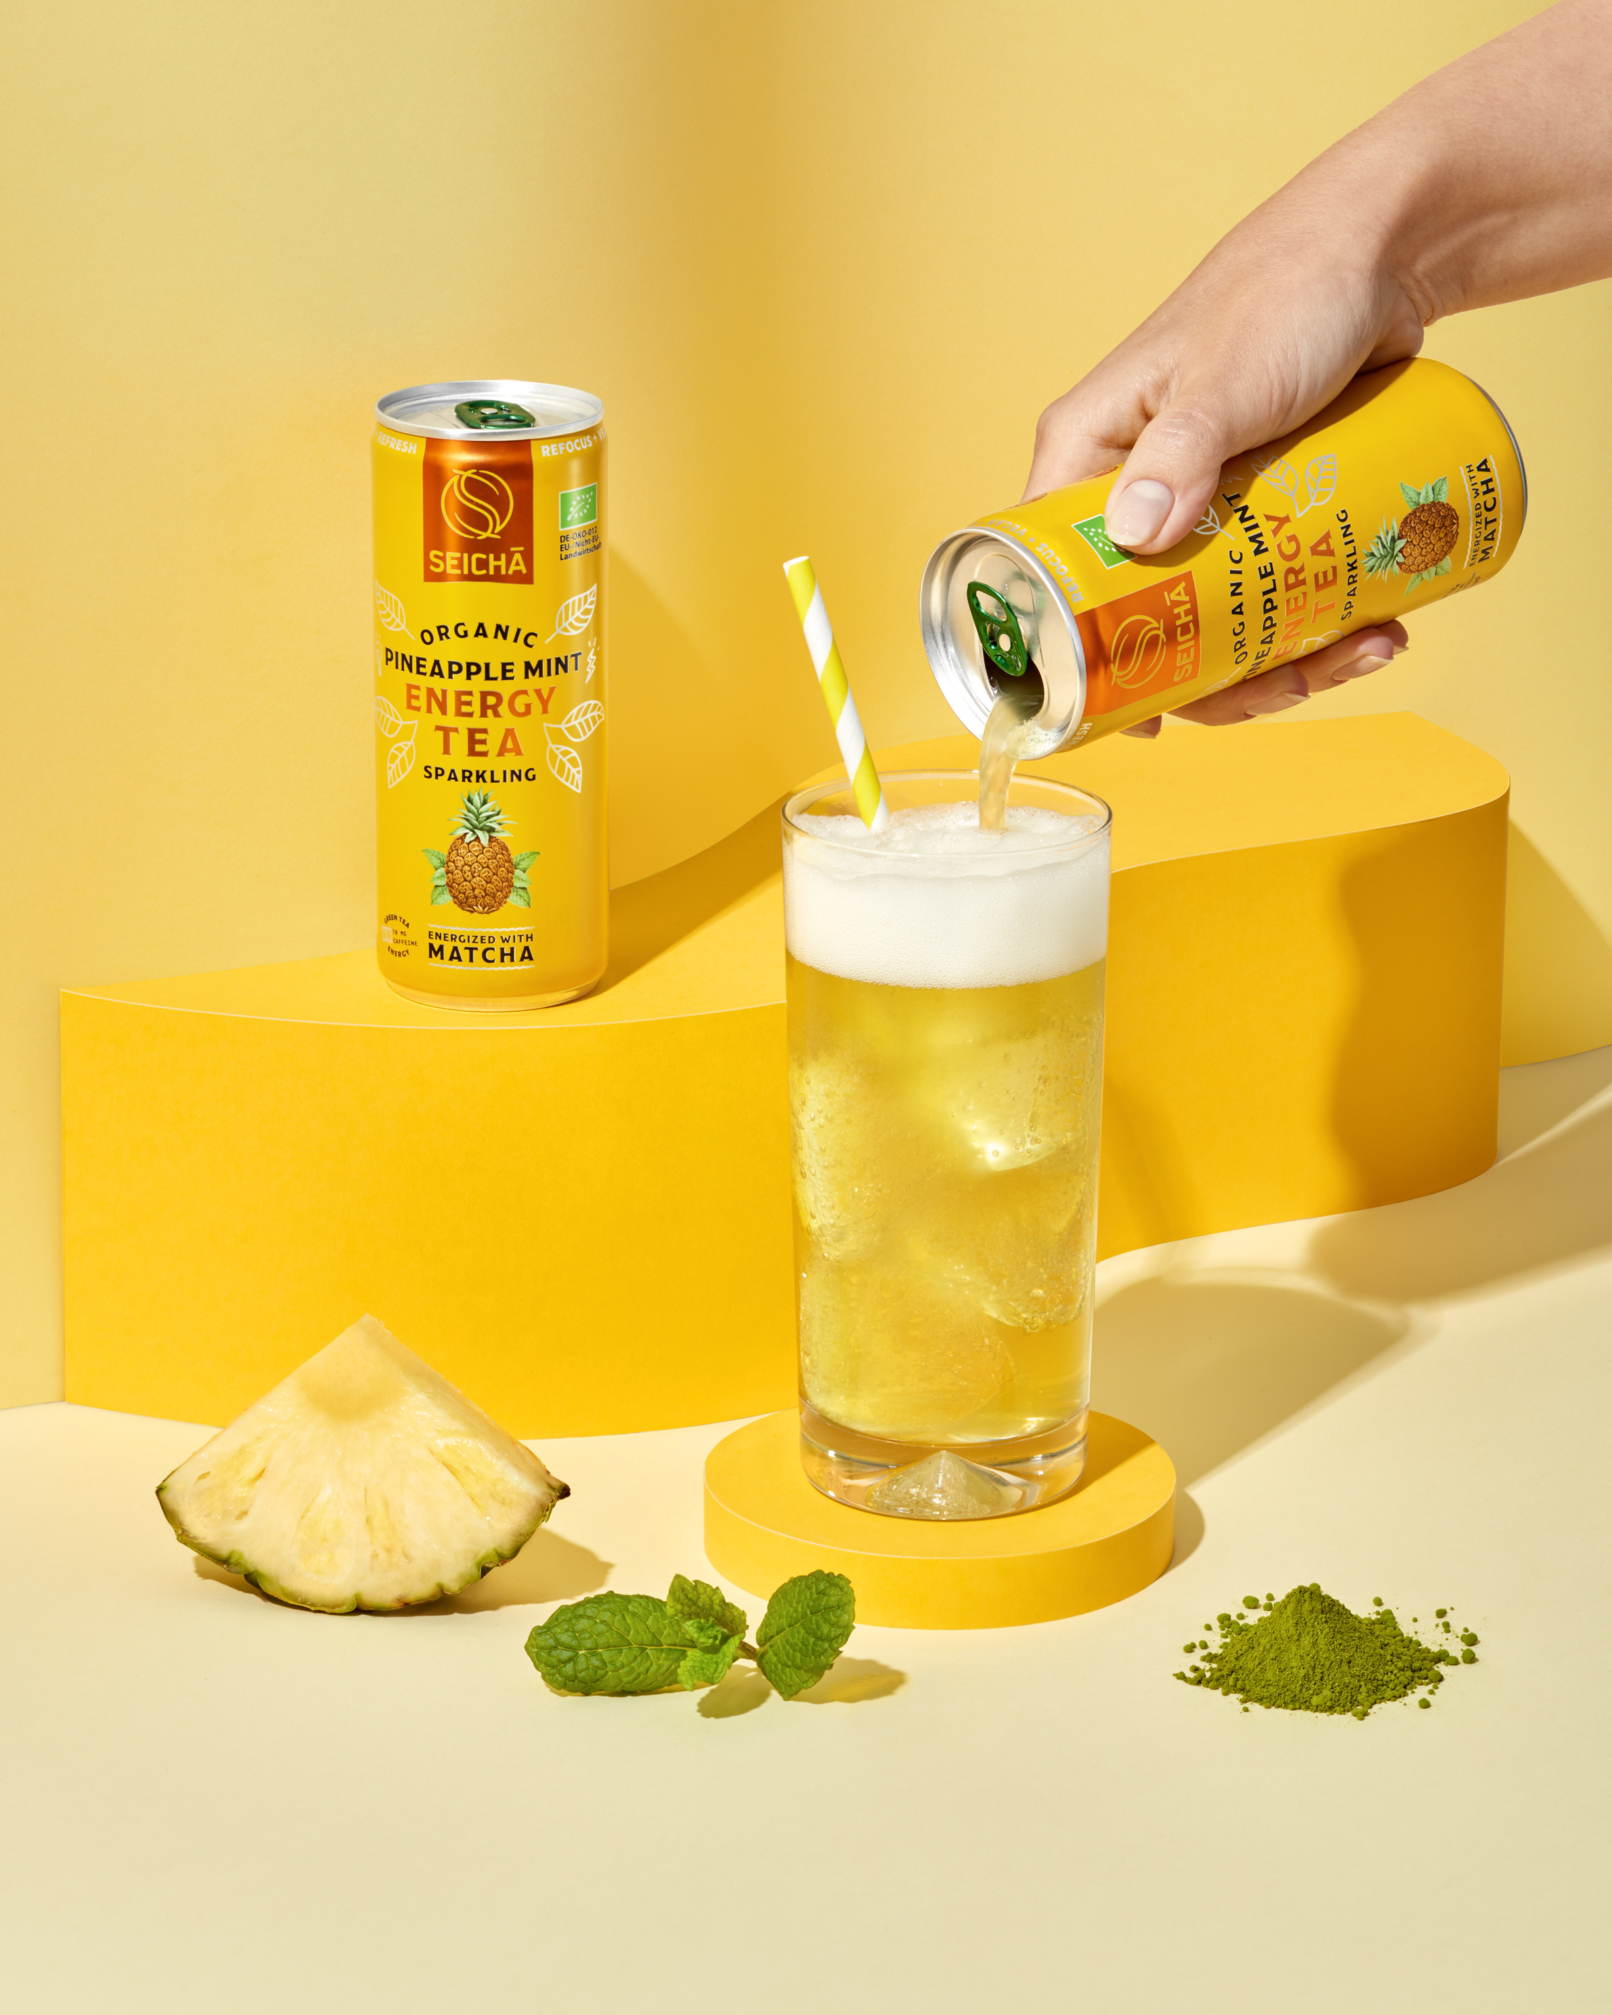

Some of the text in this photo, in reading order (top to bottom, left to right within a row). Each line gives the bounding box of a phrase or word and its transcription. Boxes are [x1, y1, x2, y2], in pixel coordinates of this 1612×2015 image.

[377, 431, 417, 454] REFRESH
[541, 435, 592, 457] REFOCUS
[986, 518, 1027, 537] VEGAN
[1221, 491, 1269, 557] MINT
[1465, 463, 1482, 567] ENERGIZED WITH
[1476, 457, 1497, 564] MATCHA
[429, 547, 527, 575] SEICHĀ
[1036, 543, 1084, 603] REFOCUS
[1309, 528, 1338, 624] TEA
[1336, 508, 1358, 621] SPARKLING
[1263, 512, 1307, 661] ENERGY
[1229, 549, 1248, 665] ORGANIC
[420, 622, 538, 648] ORGANIC
[1164, 581, 1195, 682] SEICHĀ
[385, 647, 583, 681] PINEAPPLE MINT
[405, 682, 557, 719] ENERGY
[434, 724, 525, 758] TEA
[423, 765, 537, 783] SPARKLING
[398, 915, 410, 929] TEA
[428, 930, 534, 944] ENERGIZED WITH
[387, 945, 410, 957] ENERGY
[392, 937, 418, 946] CAFFEINE
[428, 942, 535, 964] MATCHA
